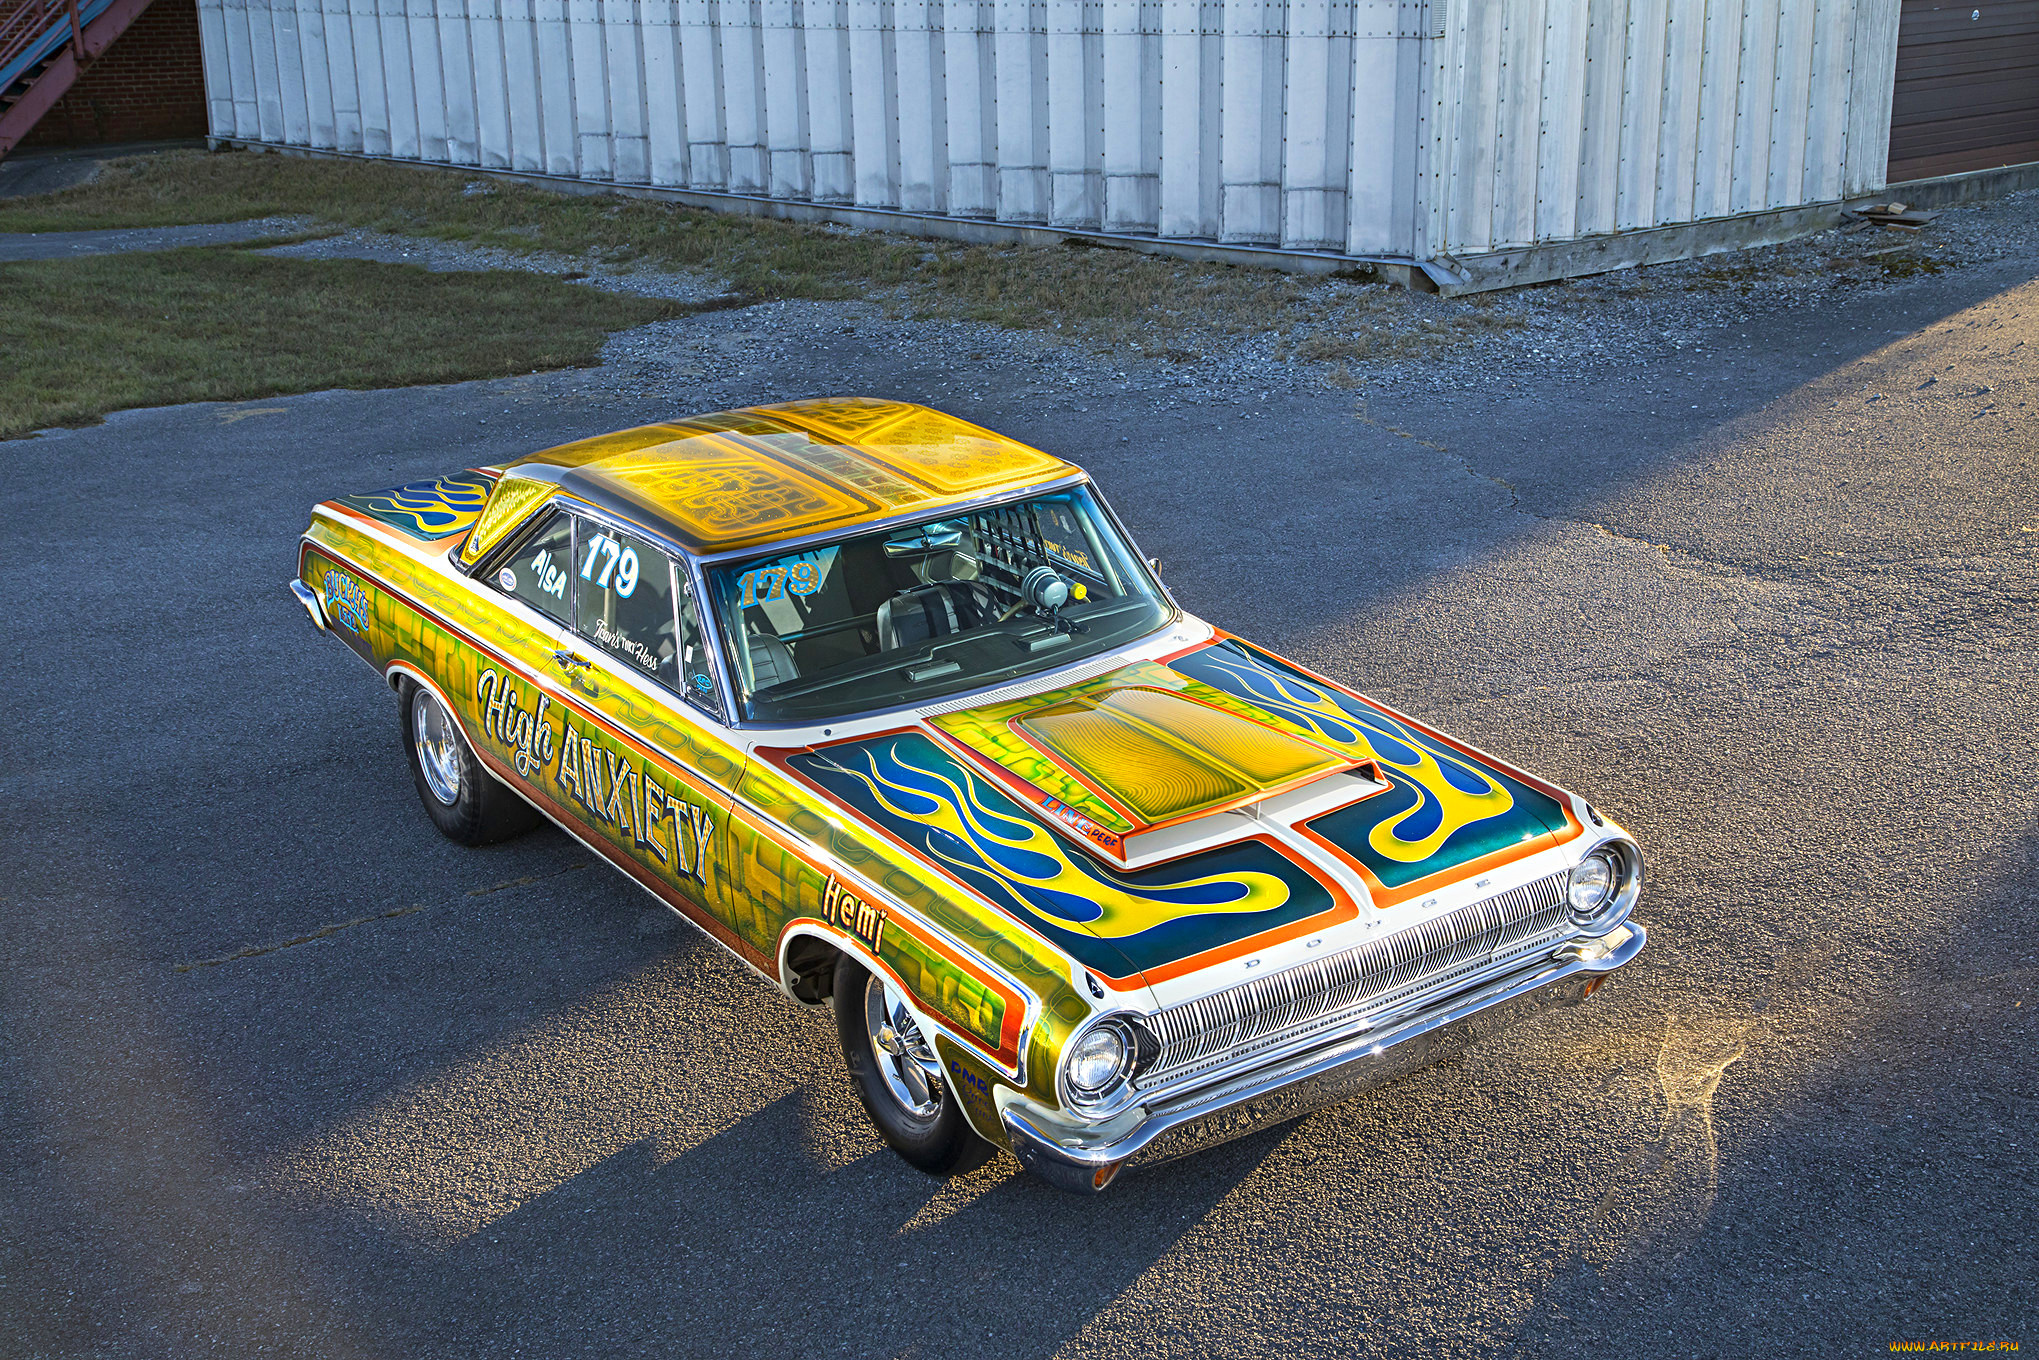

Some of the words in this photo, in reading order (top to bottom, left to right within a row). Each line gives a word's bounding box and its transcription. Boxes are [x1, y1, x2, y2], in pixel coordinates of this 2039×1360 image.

[531, 548, 567, 600] A/SA
[580, 532, 640, 599] 179
[737, 560, 822, 610] 179
[634, 642, 658, 670] Hess
[477, 668, 554, 777] High
[556, 722, 716, 886] ANXIETY
[1091, 828, 1118, 847] PERF
[821, 872, 888, 957] Hemi
